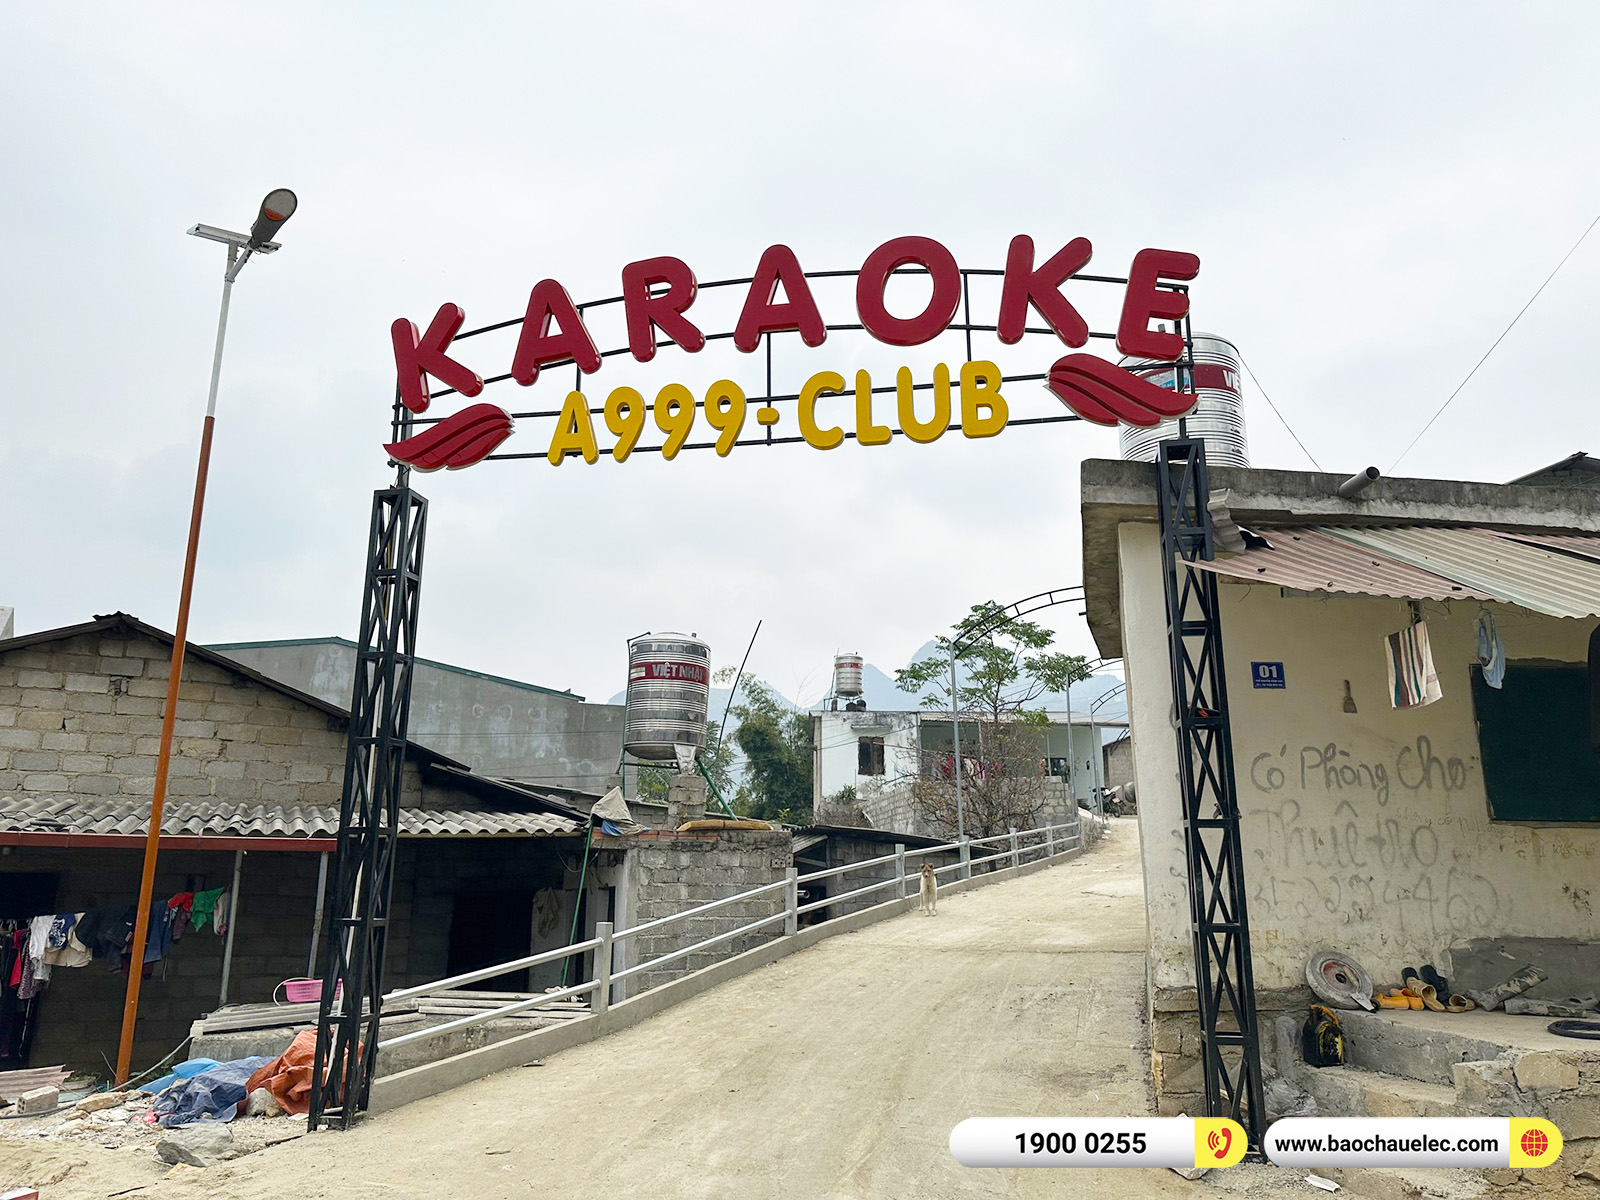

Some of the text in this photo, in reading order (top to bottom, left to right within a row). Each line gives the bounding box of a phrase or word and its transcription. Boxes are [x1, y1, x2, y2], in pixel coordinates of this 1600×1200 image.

[391, 235, 1201, 414] KARAOKE
[652, 662, 678, 678] VIỆT
[1258, 664, 1278, 678] 01
[1250, 744, 1287, 793] Có
[1300, 743, 1389, 807] Phòng
